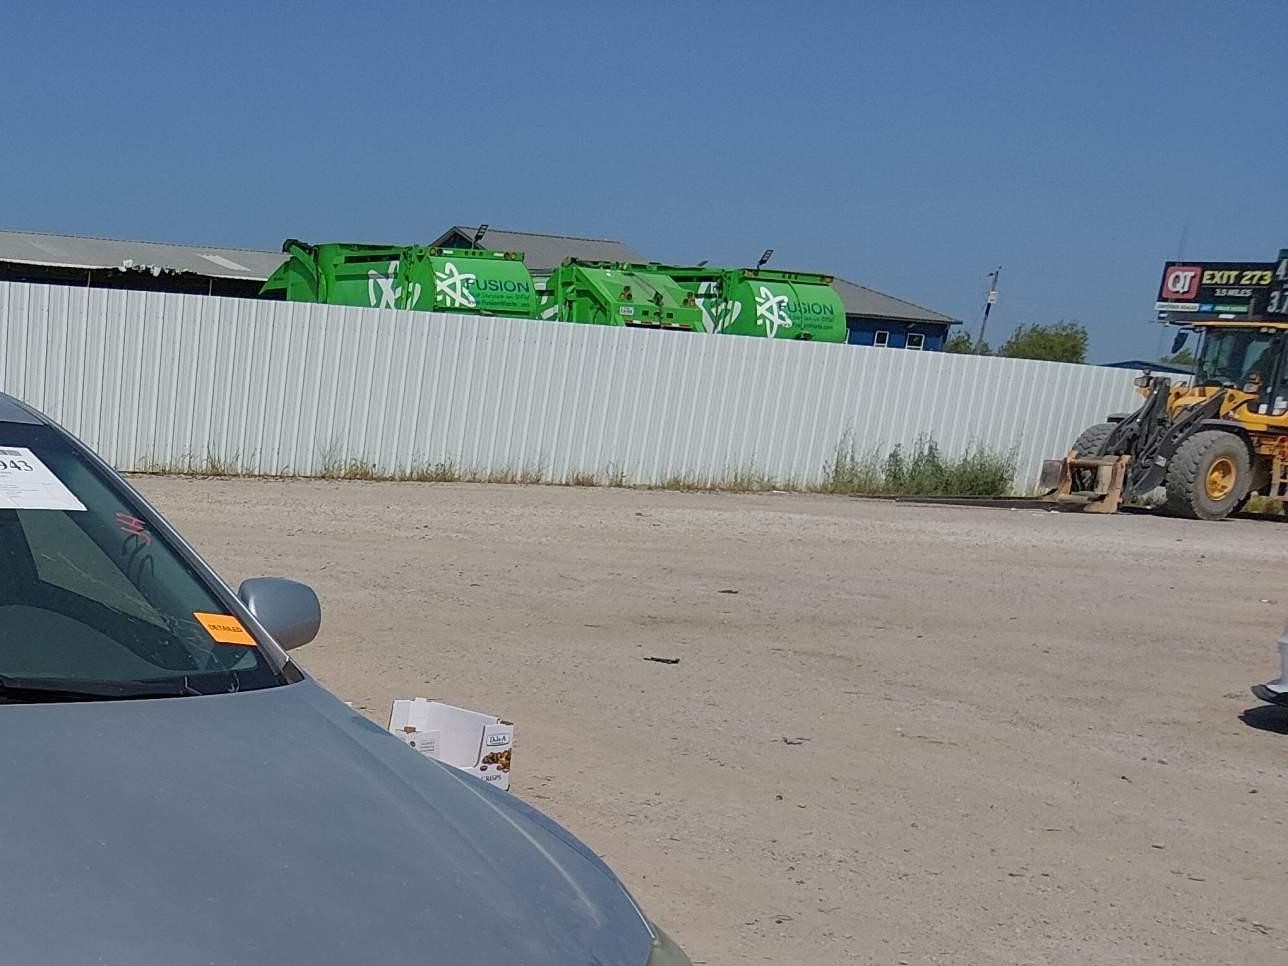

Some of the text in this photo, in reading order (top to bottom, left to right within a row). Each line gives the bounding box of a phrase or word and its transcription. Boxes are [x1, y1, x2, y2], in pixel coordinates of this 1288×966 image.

[1167, 271, 1195, 294] QT
[1202, 271, 1272, 285] EXIT 273
[465, 279, 530, 293] FUSION
[1227, 288, 1253, 297] MILES
